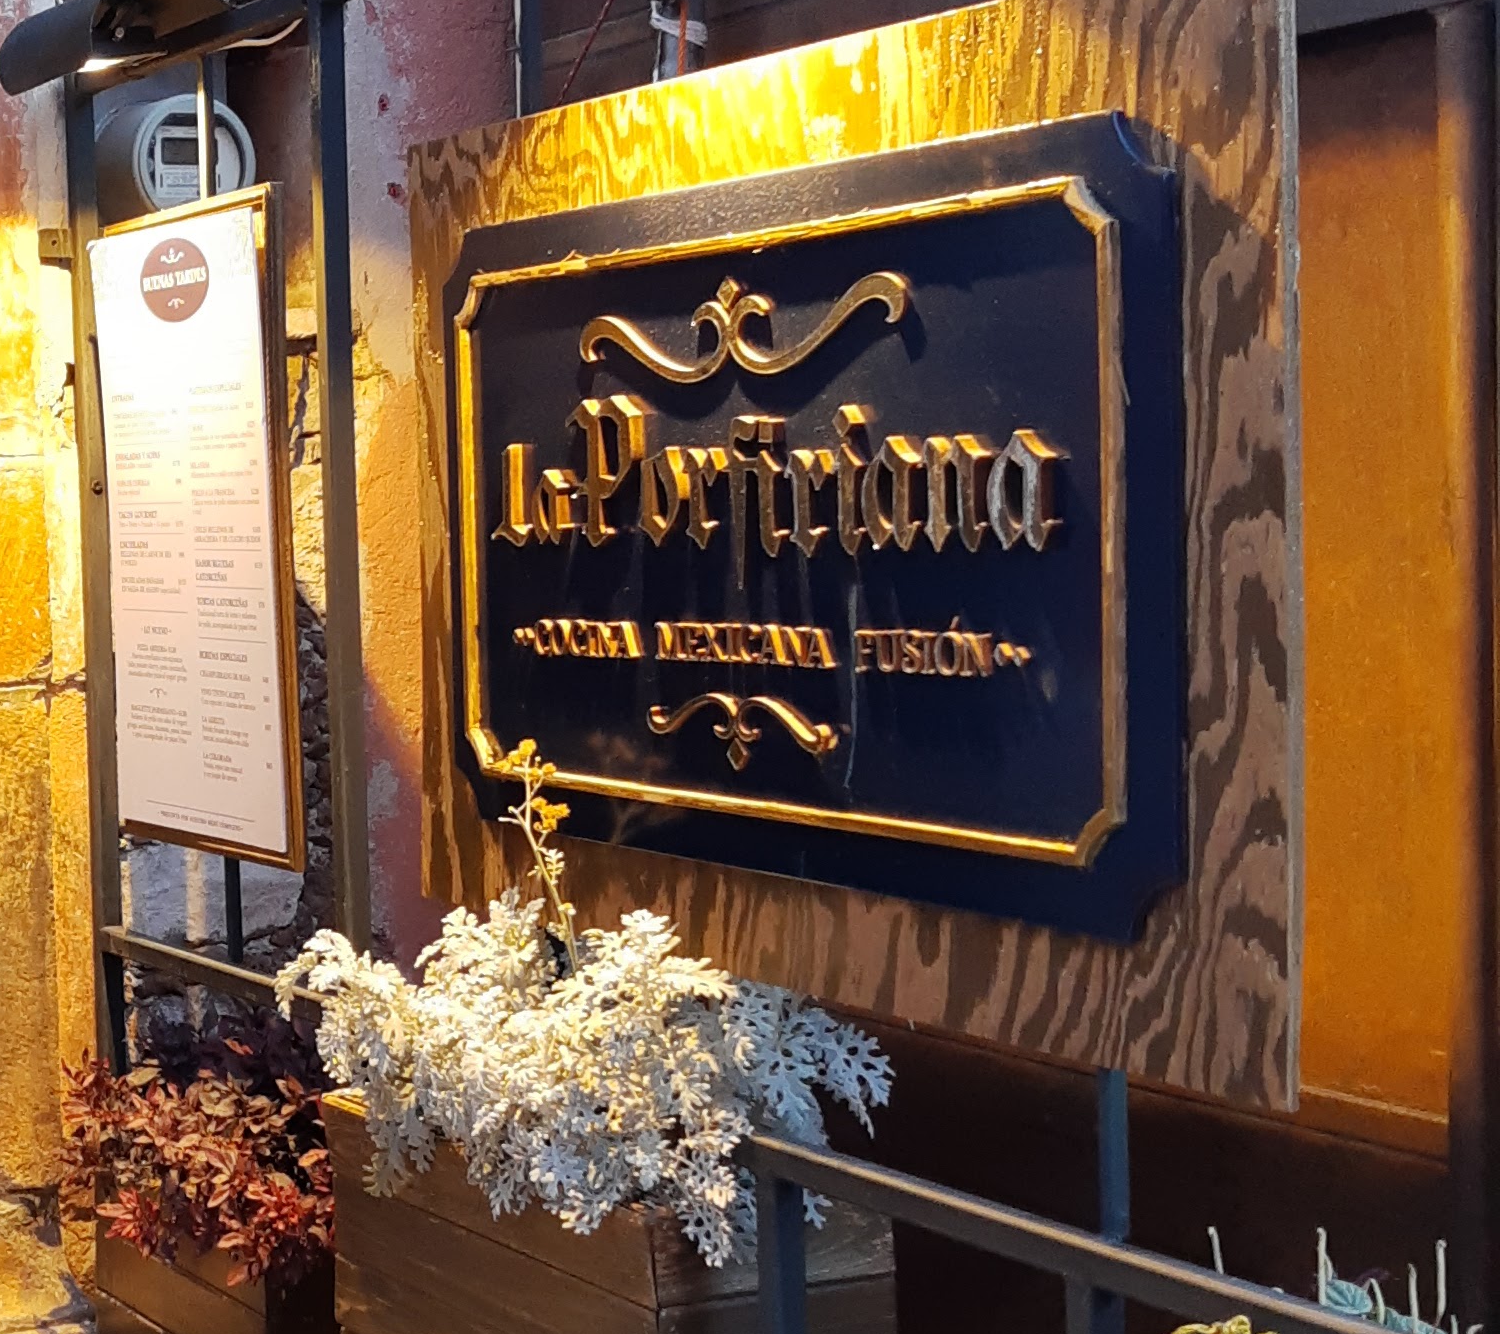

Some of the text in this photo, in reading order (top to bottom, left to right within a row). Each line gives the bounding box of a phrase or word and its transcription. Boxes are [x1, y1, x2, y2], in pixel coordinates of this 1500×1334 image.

[142, 266, 206, 292] BUENAS TARDES
[566, 395, 1066, 588] Porfiriana
[534, 615, 994, 677] COCINA MEXICANA FUSIÓN
